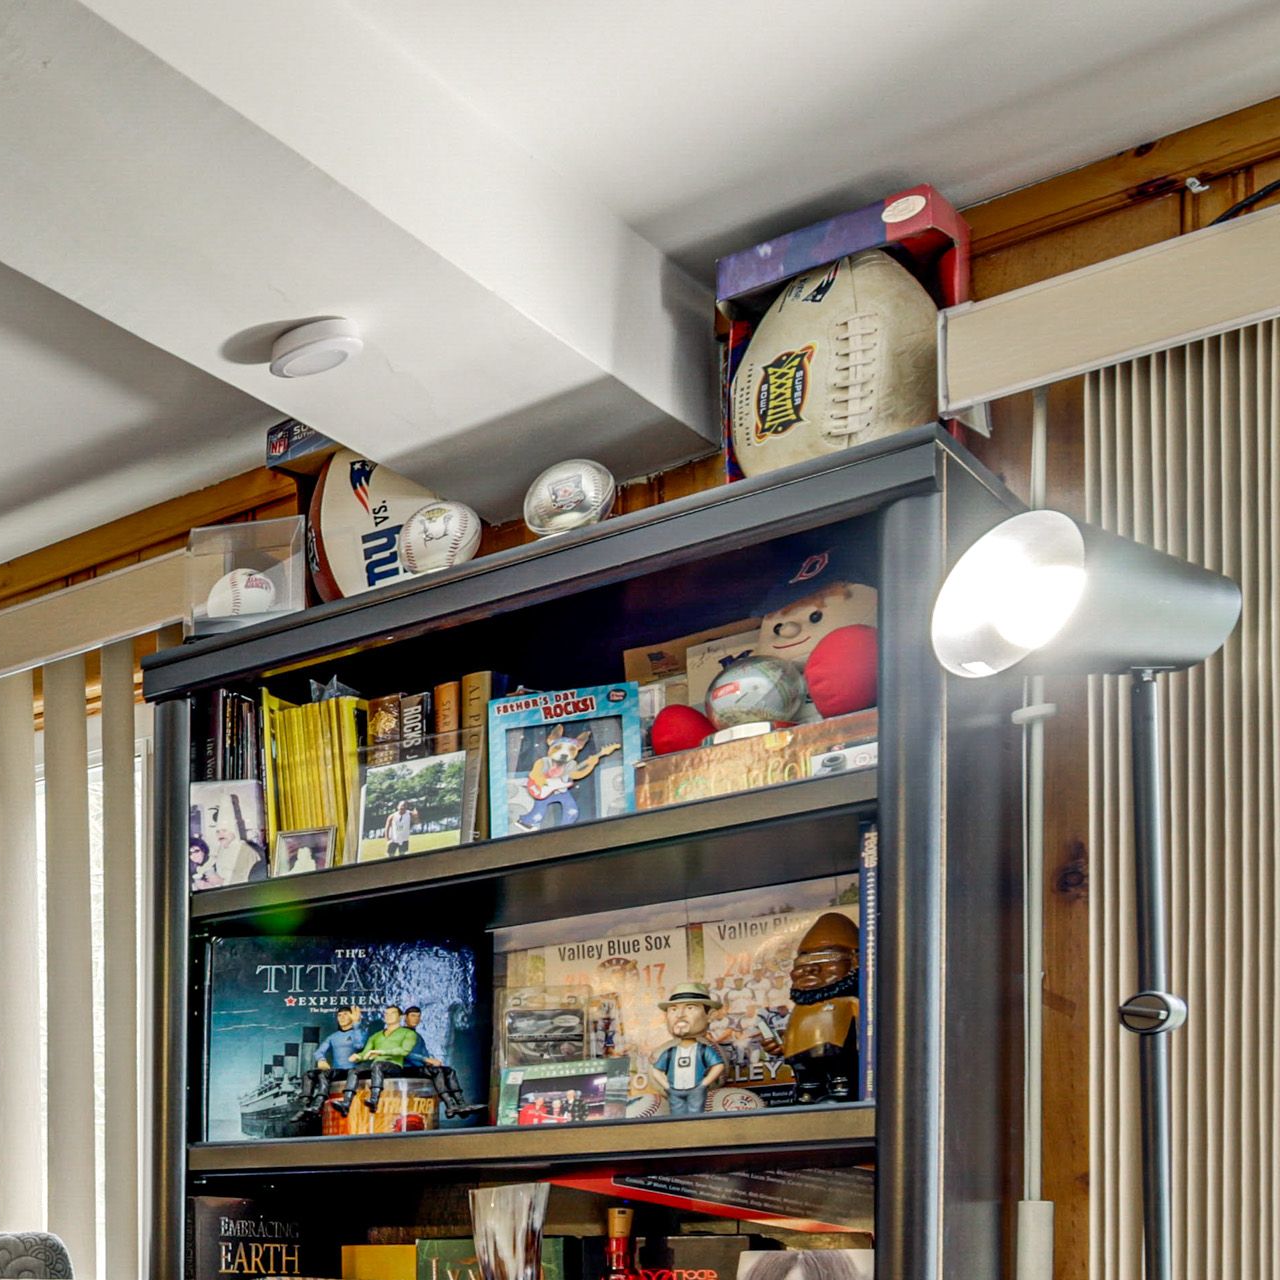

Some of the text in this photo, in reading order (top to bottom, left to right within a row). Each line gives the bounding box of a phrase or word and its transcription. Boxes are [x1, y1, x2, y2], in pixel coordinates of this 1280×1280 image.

[759, 384, 768, 415] BOWL
[793, 370, 804, 406] SUPER
[271, 437, 289, 455] NFL
[542, 697, 596, 720] ROCKS!
[403, 705, 421, 748] ROCKS
[717, 921, 768, 941] Valley
[335, 949, 366, 958] THE
[558, 935, 672, 962] Valley Blue Sox
[642, 963, 667, 986] 17
[219, 1216, 300, 1239] EMBRACING
[218, 1242, 301, 1275] EARTH
